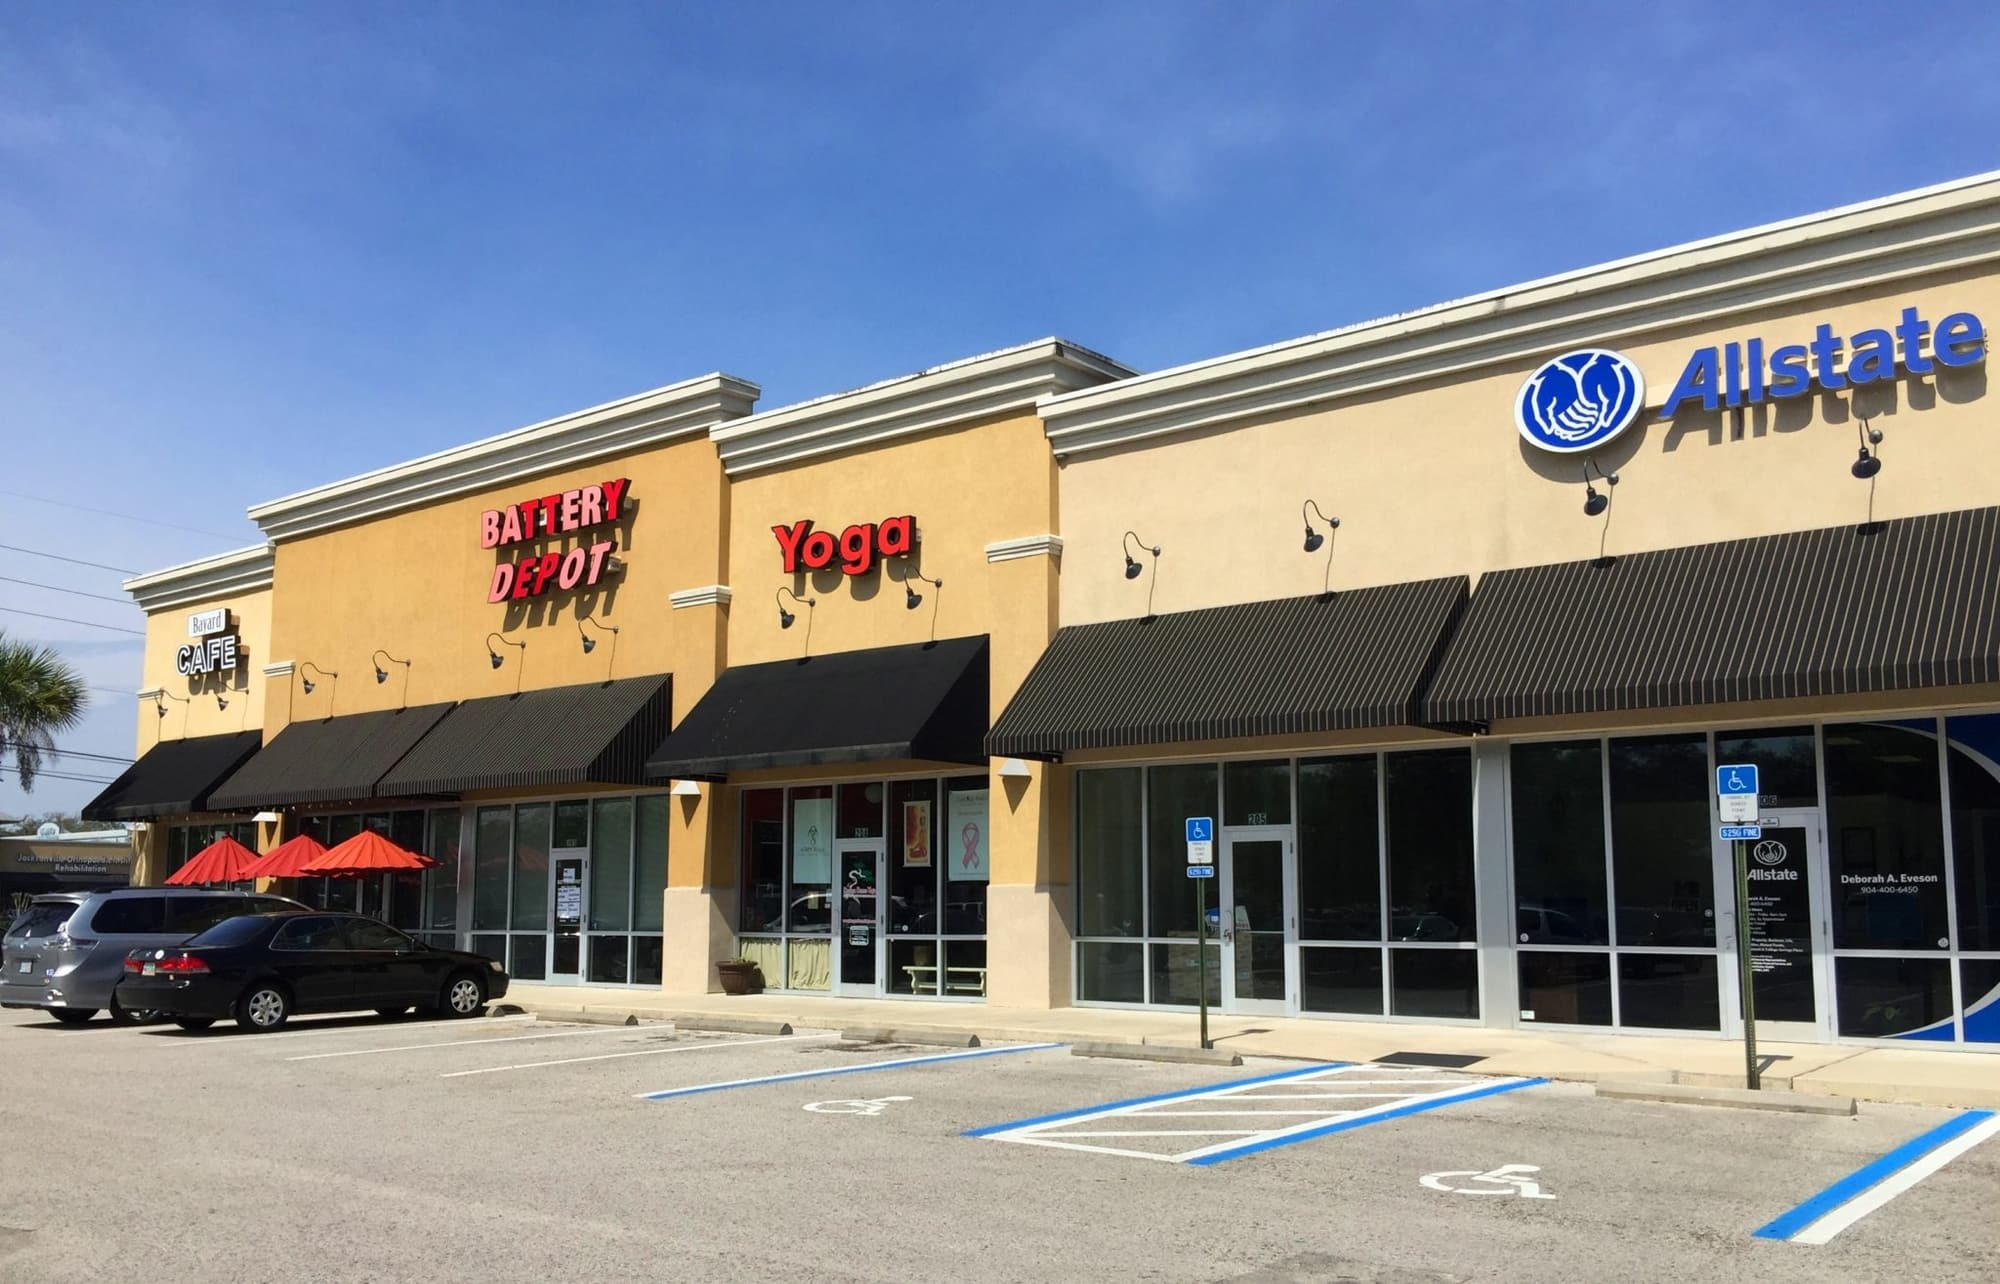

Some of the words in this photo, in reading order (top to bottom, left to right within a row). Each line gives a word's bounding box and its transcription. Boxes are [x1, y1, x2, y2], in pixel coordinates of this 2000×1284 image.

[1657, 306, 1986, 420] Allstate
[481, 478, 631, 550] BATTERY
[771, 515, 916, 575] Yoga
[487, 541, 617, 604] DEPOT
[192, 611, 222, 634] Bayard
[176, 635, 237, 676] CAFE
[1248, 814, 1266, 825] 205
[55, 864, 107, 873] Rehabilitation
[1747, 868, 1798, 881] Allstate
[1841, 874, 1884, 884] Deborah
[1886, 873, 1898, 883] A.
[1900, 873, 1938, 883] Eveson
[1861, 885, 1919, 894] 904-400-6450
